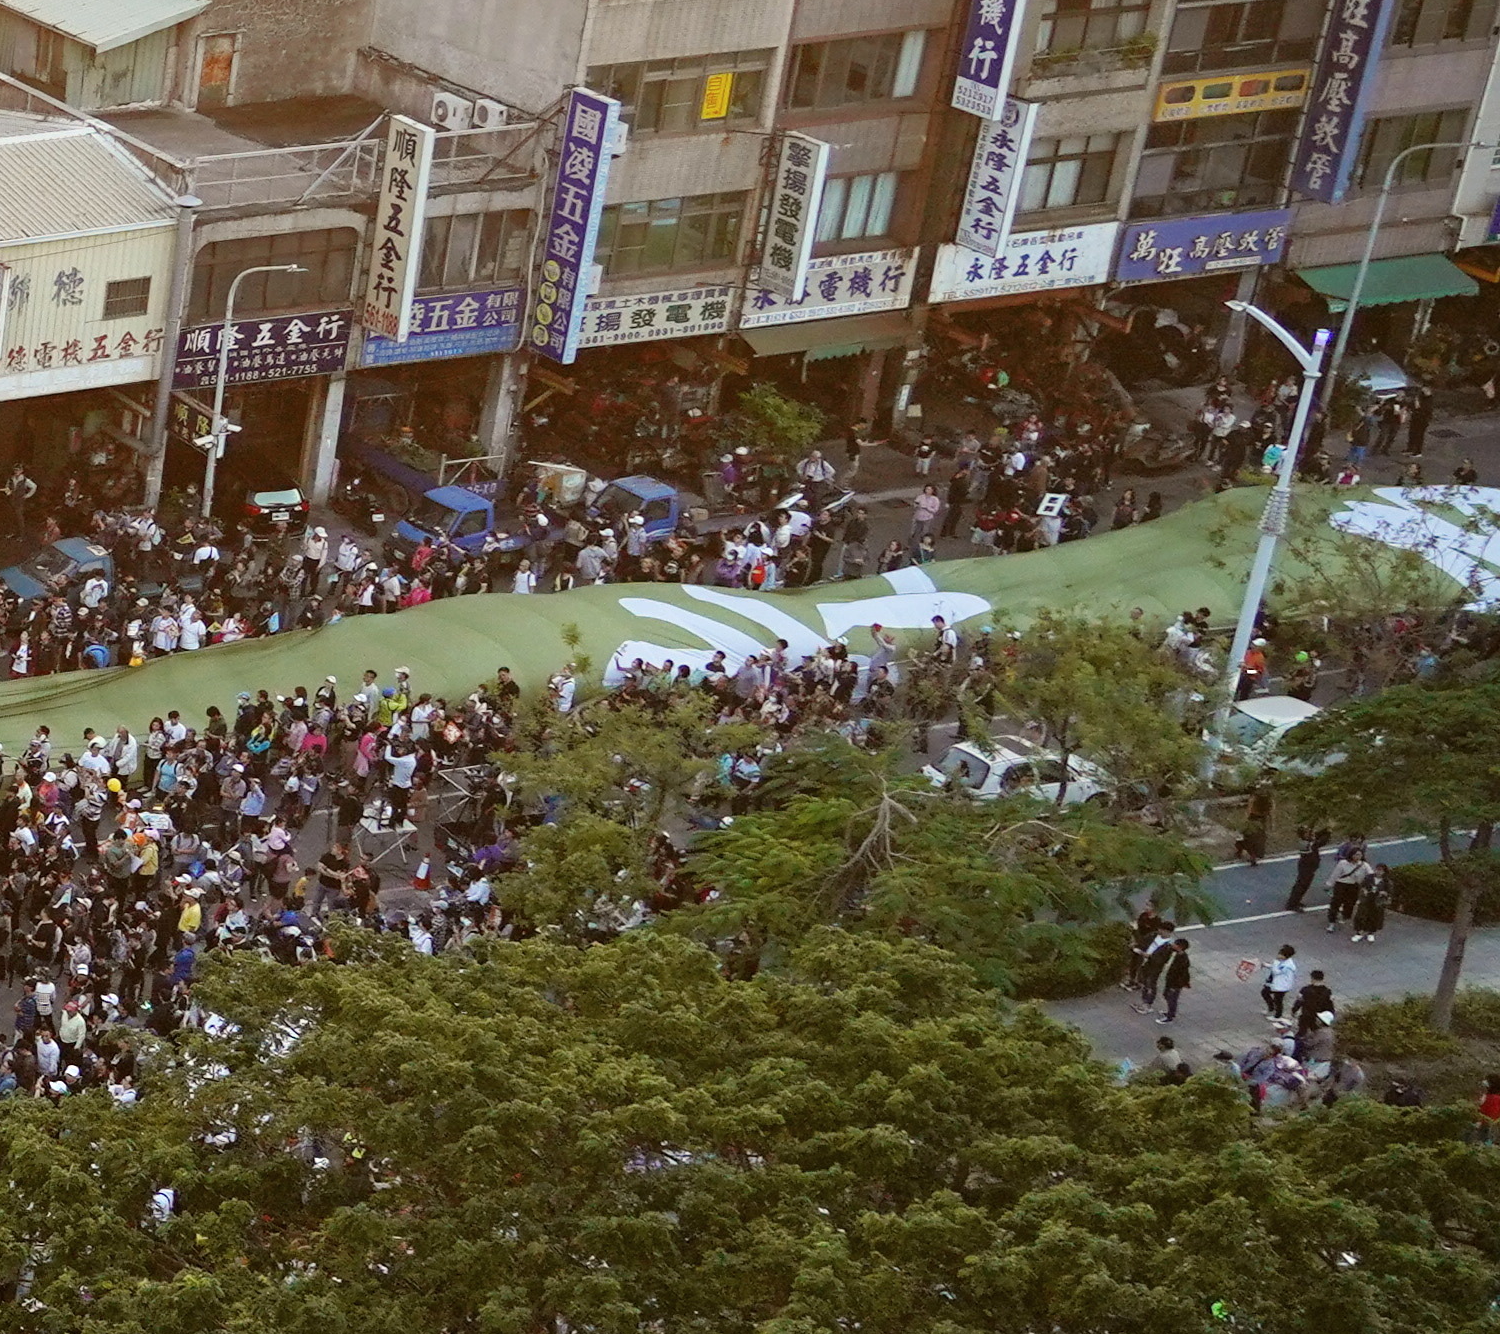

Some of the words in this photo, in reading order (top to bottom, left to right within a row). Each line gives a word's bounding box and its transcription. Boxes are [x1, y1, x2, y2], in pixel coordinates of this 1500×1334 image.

[970, 130, 1017, 242] 永隆五金行
[372, 127, 418, 309] 順隆五金行
[965, 247, 1080, 283] 永隆五金行
[184, 313, 345, 355] 順隆五金行
[580, 300, 727, 334] 揚發電機
[208, 369, 260, 385] 51-1188
